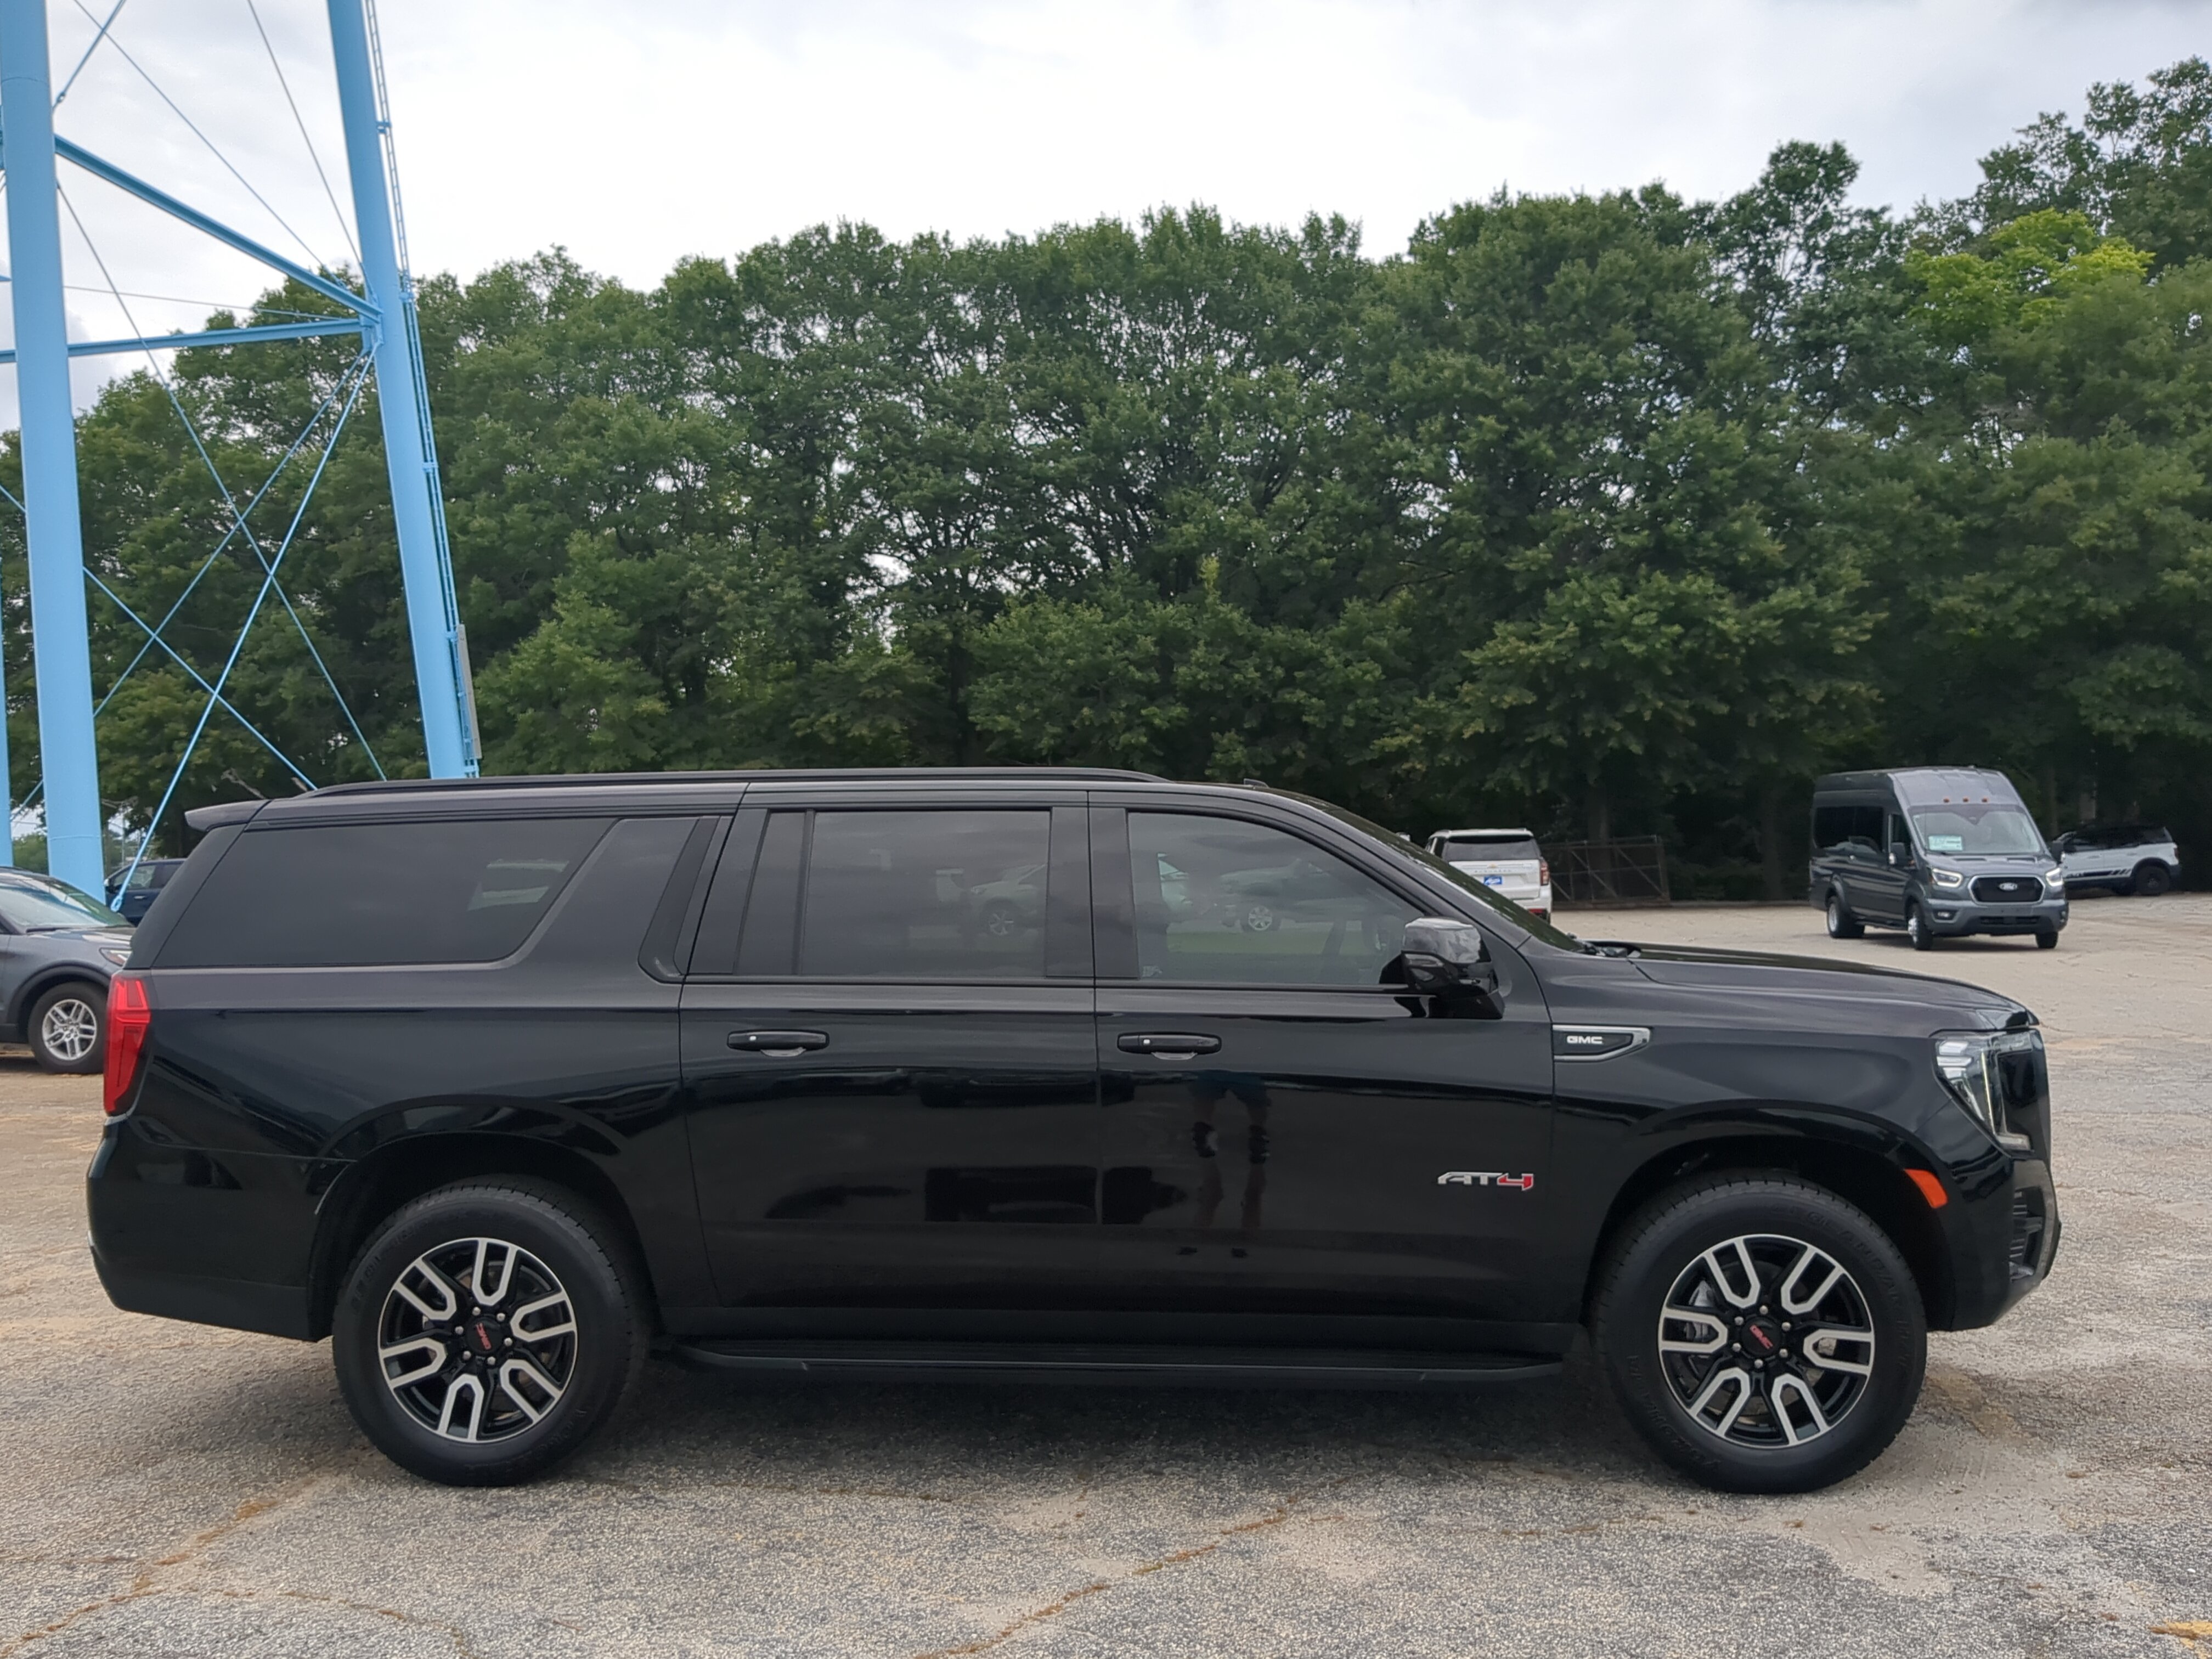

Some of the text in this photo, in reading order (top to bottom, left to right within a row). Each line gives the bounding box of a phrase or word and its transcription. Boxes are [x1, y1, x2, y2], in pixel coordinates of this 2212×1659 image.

[1567, 1036, 1603, 1044] GMC
[1438, 1172, 1533, 1191] AT4
[1750, 1325, 1773, 1350] GMC
